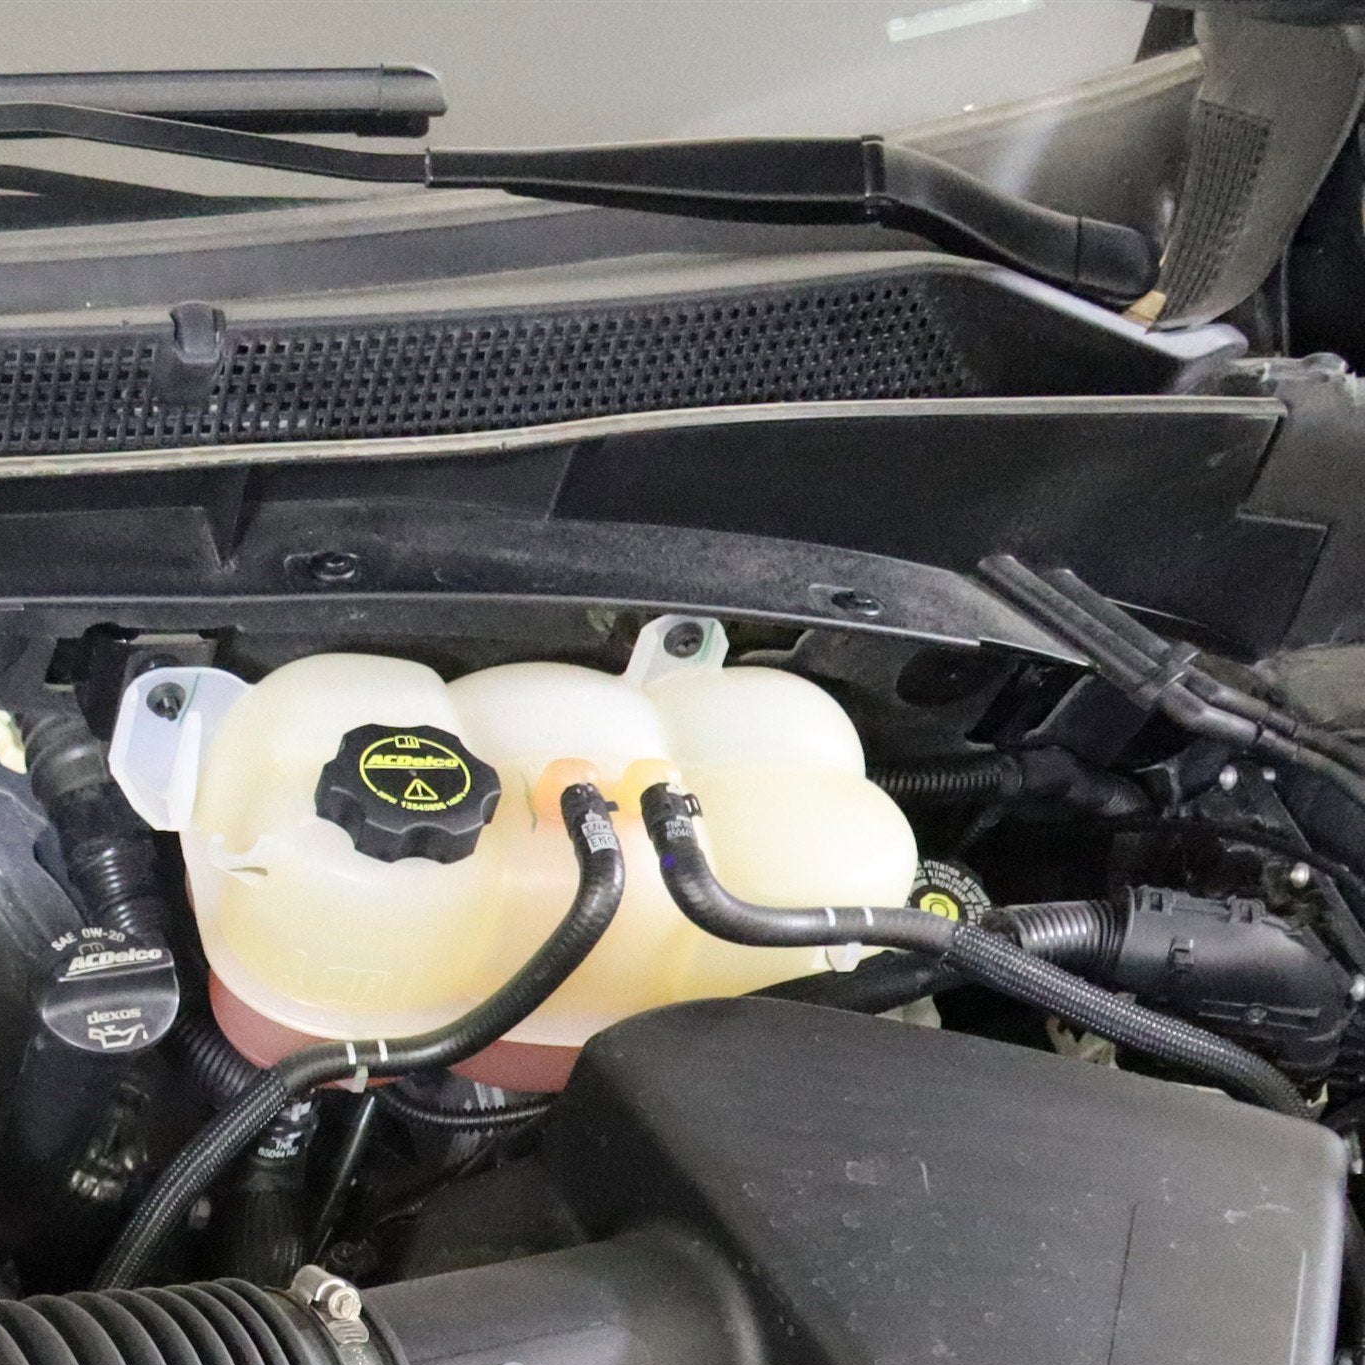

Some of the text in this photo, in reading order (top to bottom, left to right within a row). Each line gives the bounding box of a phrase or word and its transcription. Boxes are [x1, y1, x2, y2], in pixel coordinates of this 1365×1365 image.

[365, 754, 460, 768] ACDelco
[51, 927, 126, 952] SAE 0W-20
[67, 947, 163, 972] ACDelco
[86, 1007, 142, 1025] dexos
